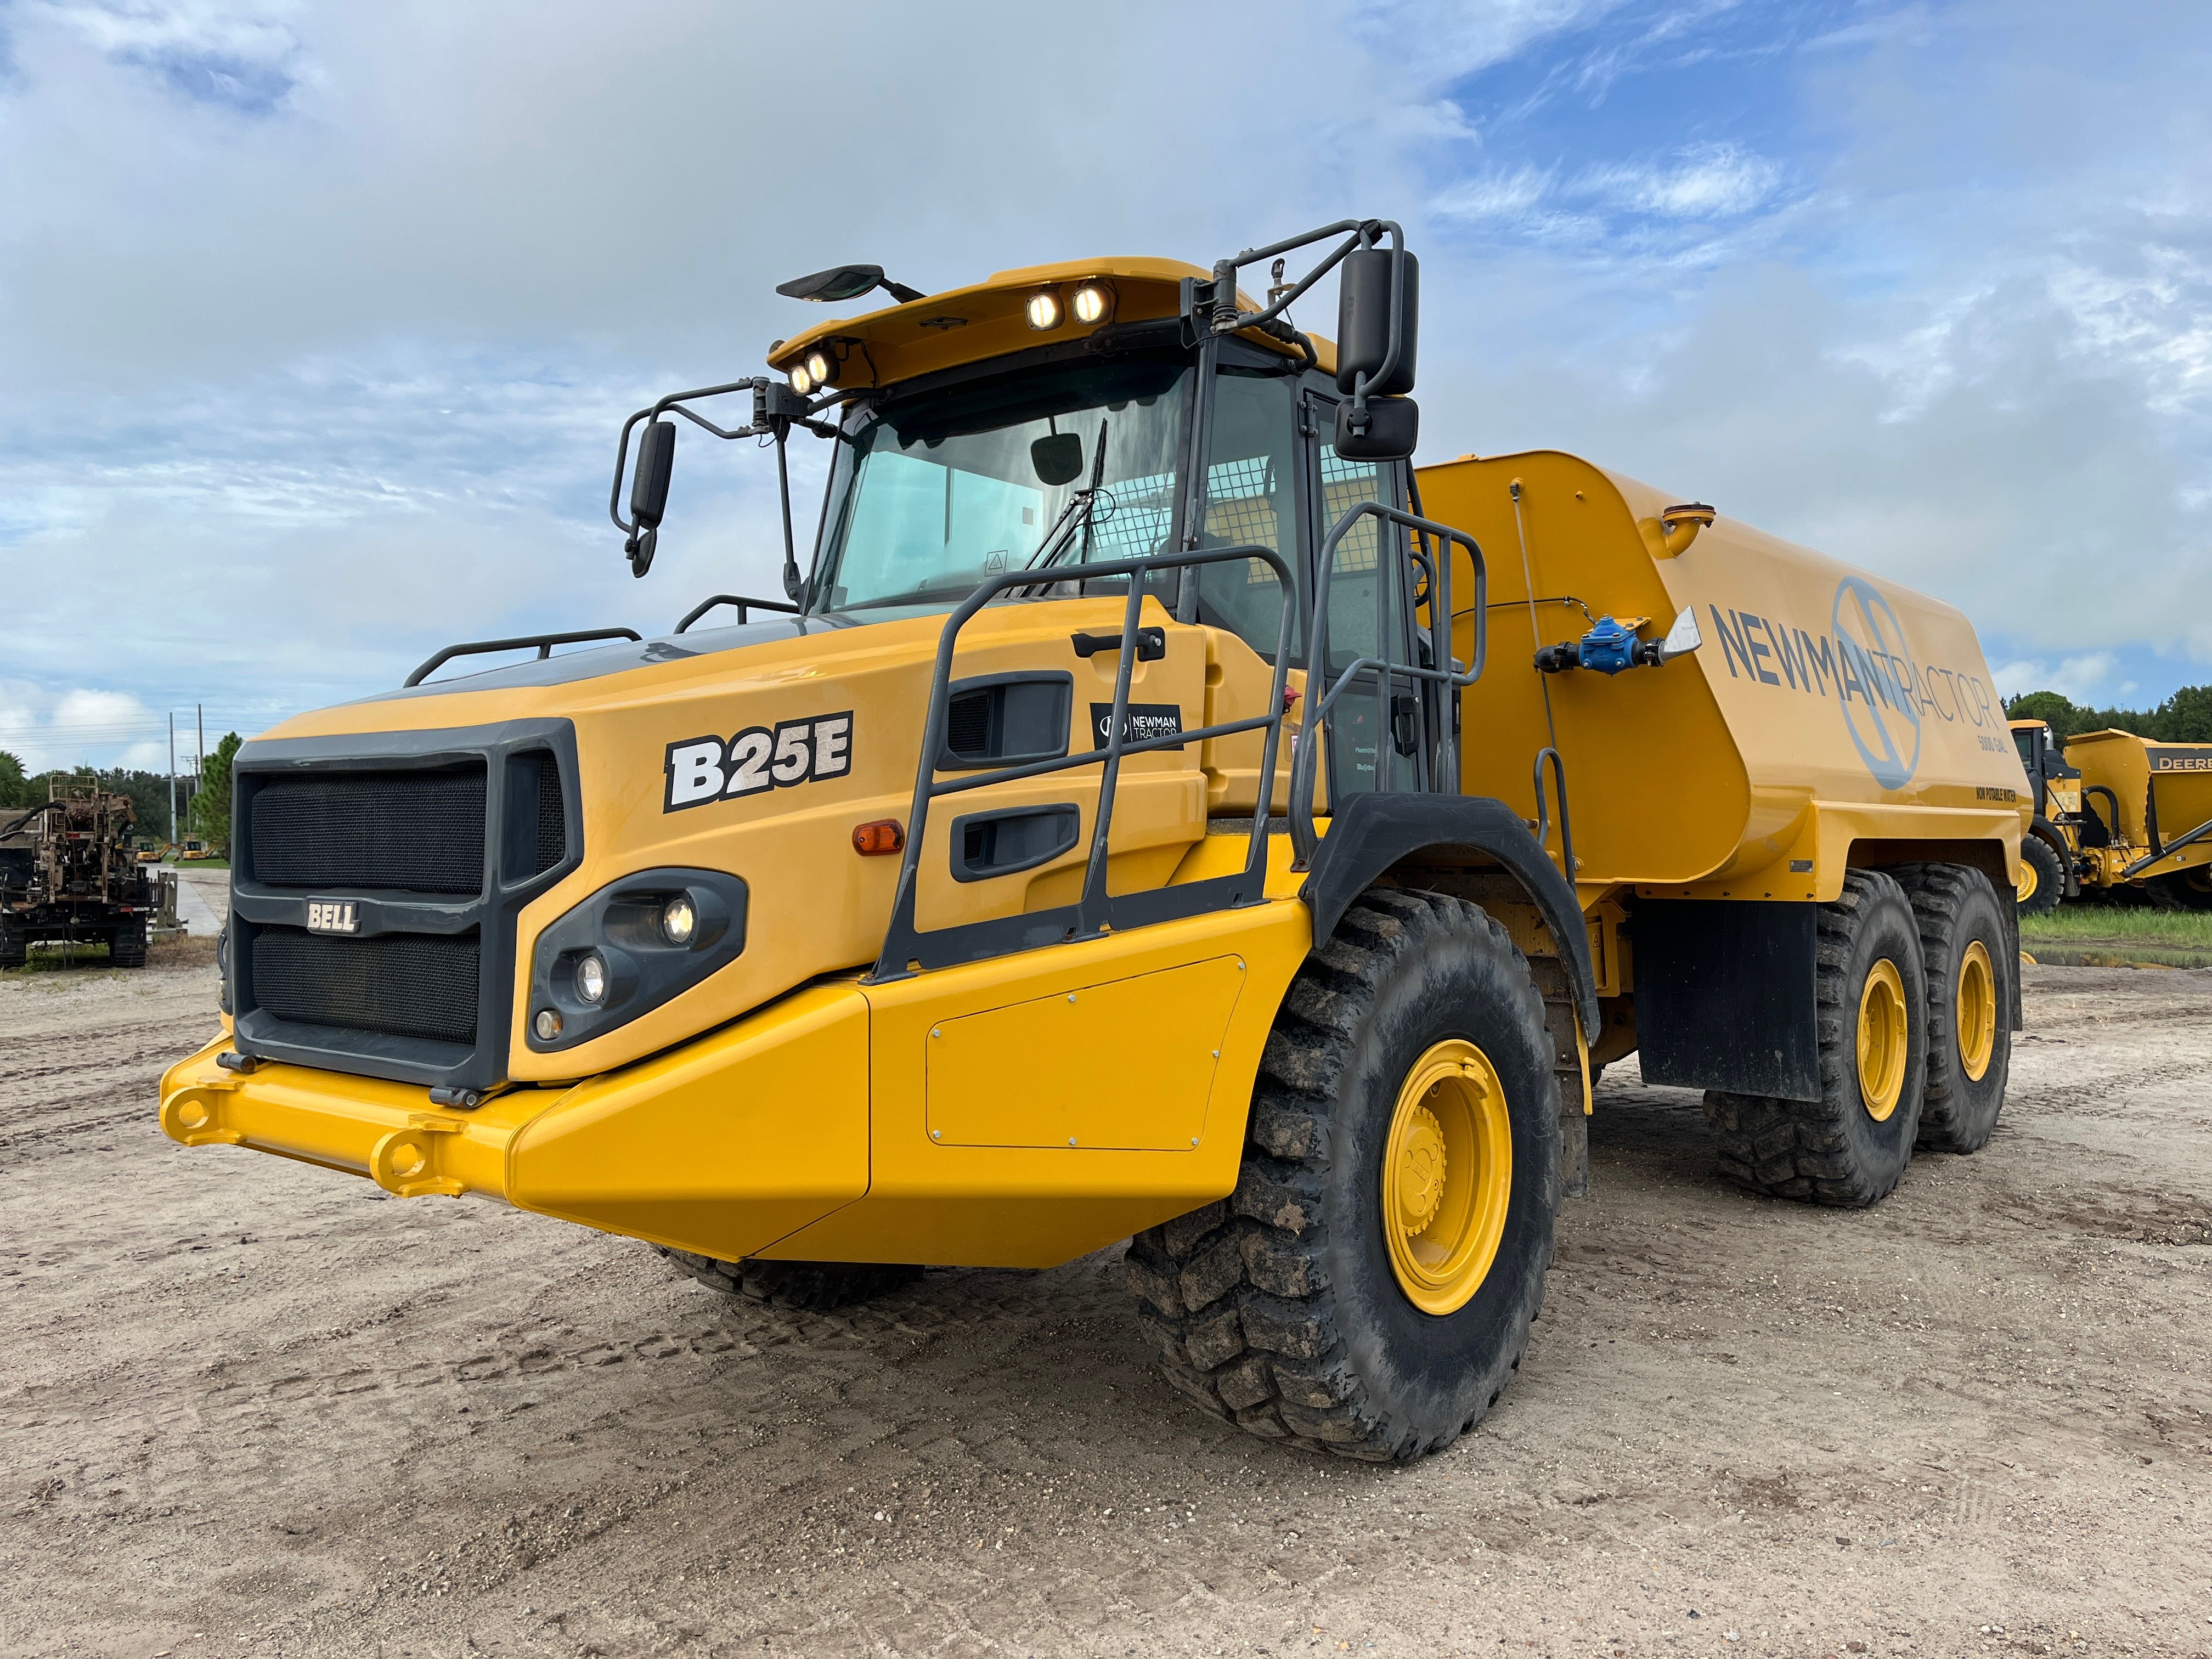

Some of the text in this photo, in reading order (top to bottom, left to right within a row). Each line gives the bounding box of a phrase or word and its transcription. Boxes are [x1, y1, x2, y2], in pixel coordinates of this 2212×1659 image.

[1133, 716, 1176, 728] NEWMAN
[671, 718, 848, 805] B25E
[1986, 787, 2003, 801] POTABLE
[2002, 788, 2017, 803] WATER
[308, 903, 355, 931] BELL
